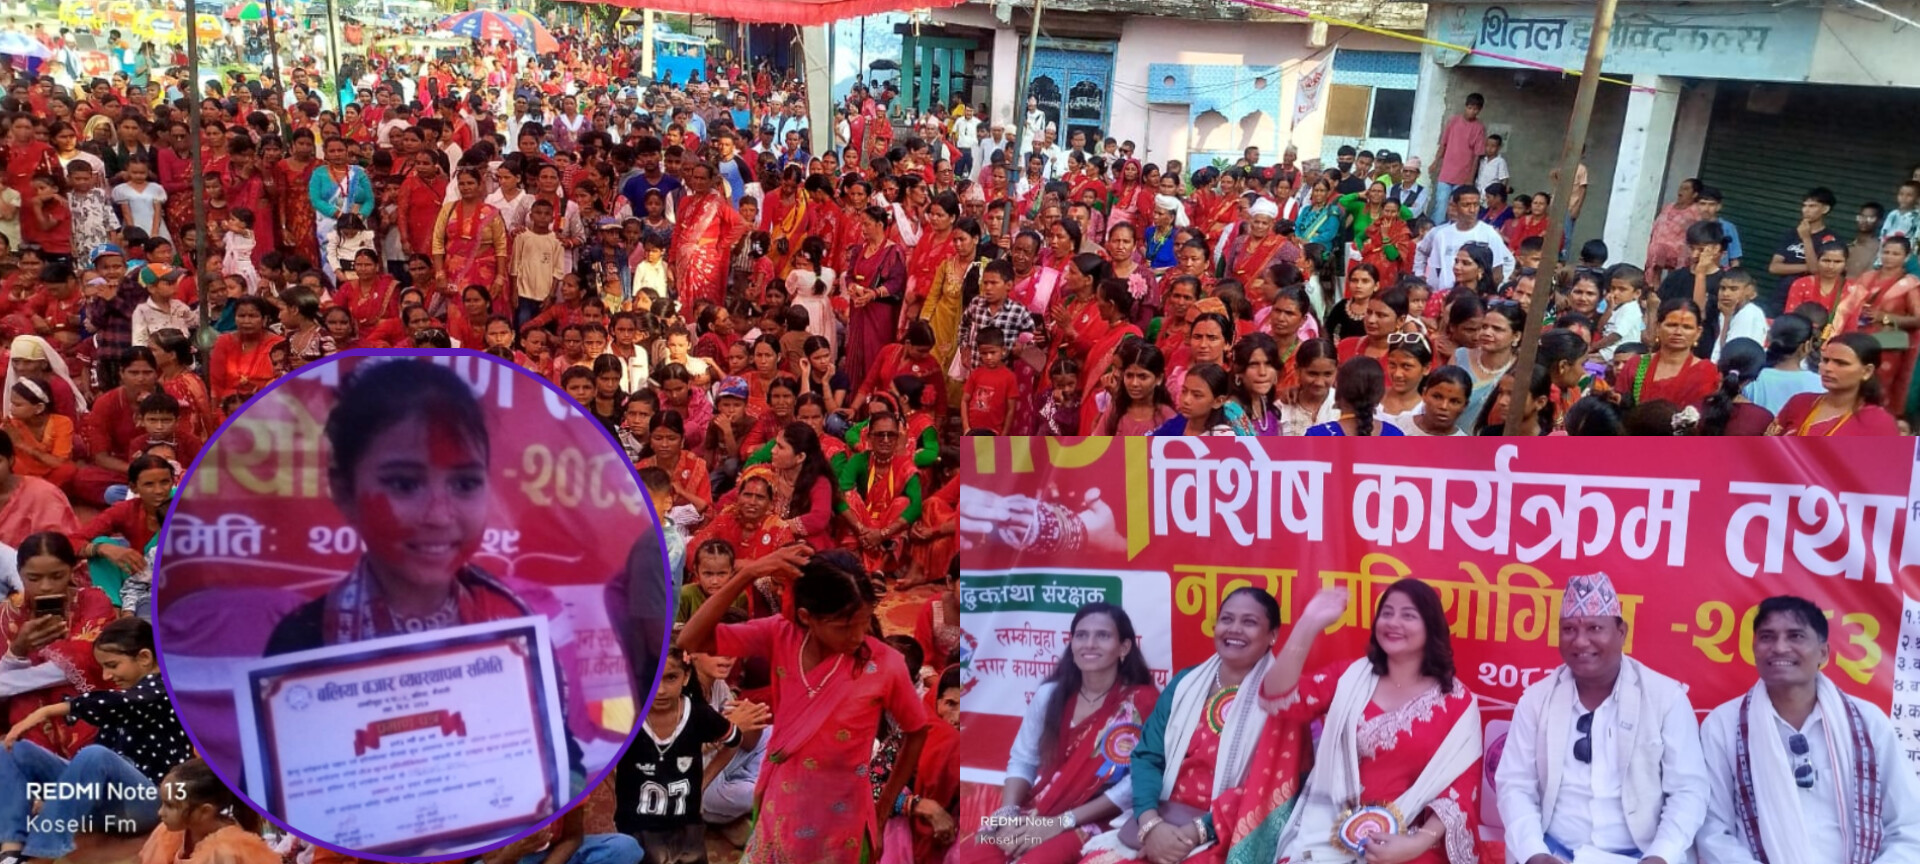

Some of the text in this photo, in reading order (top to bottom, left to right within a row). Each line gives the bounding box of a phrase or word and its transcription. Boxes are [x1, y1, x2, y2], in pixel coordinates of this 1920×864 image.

[1480, 7, 1567, 50] शितल
[1150, 436, 1332, 546] विशेष
[1352, 444, 1700, 567] कार्यक्रम
[1725, 481, 1907, 584] तथा
[1041, 580, 1107, 607] संरक्षक
[995, 622, 1057, 656] लम्कीचुहा
[975, 658, 1007, 678] नगर
[636, 779, 691, 815] 07
